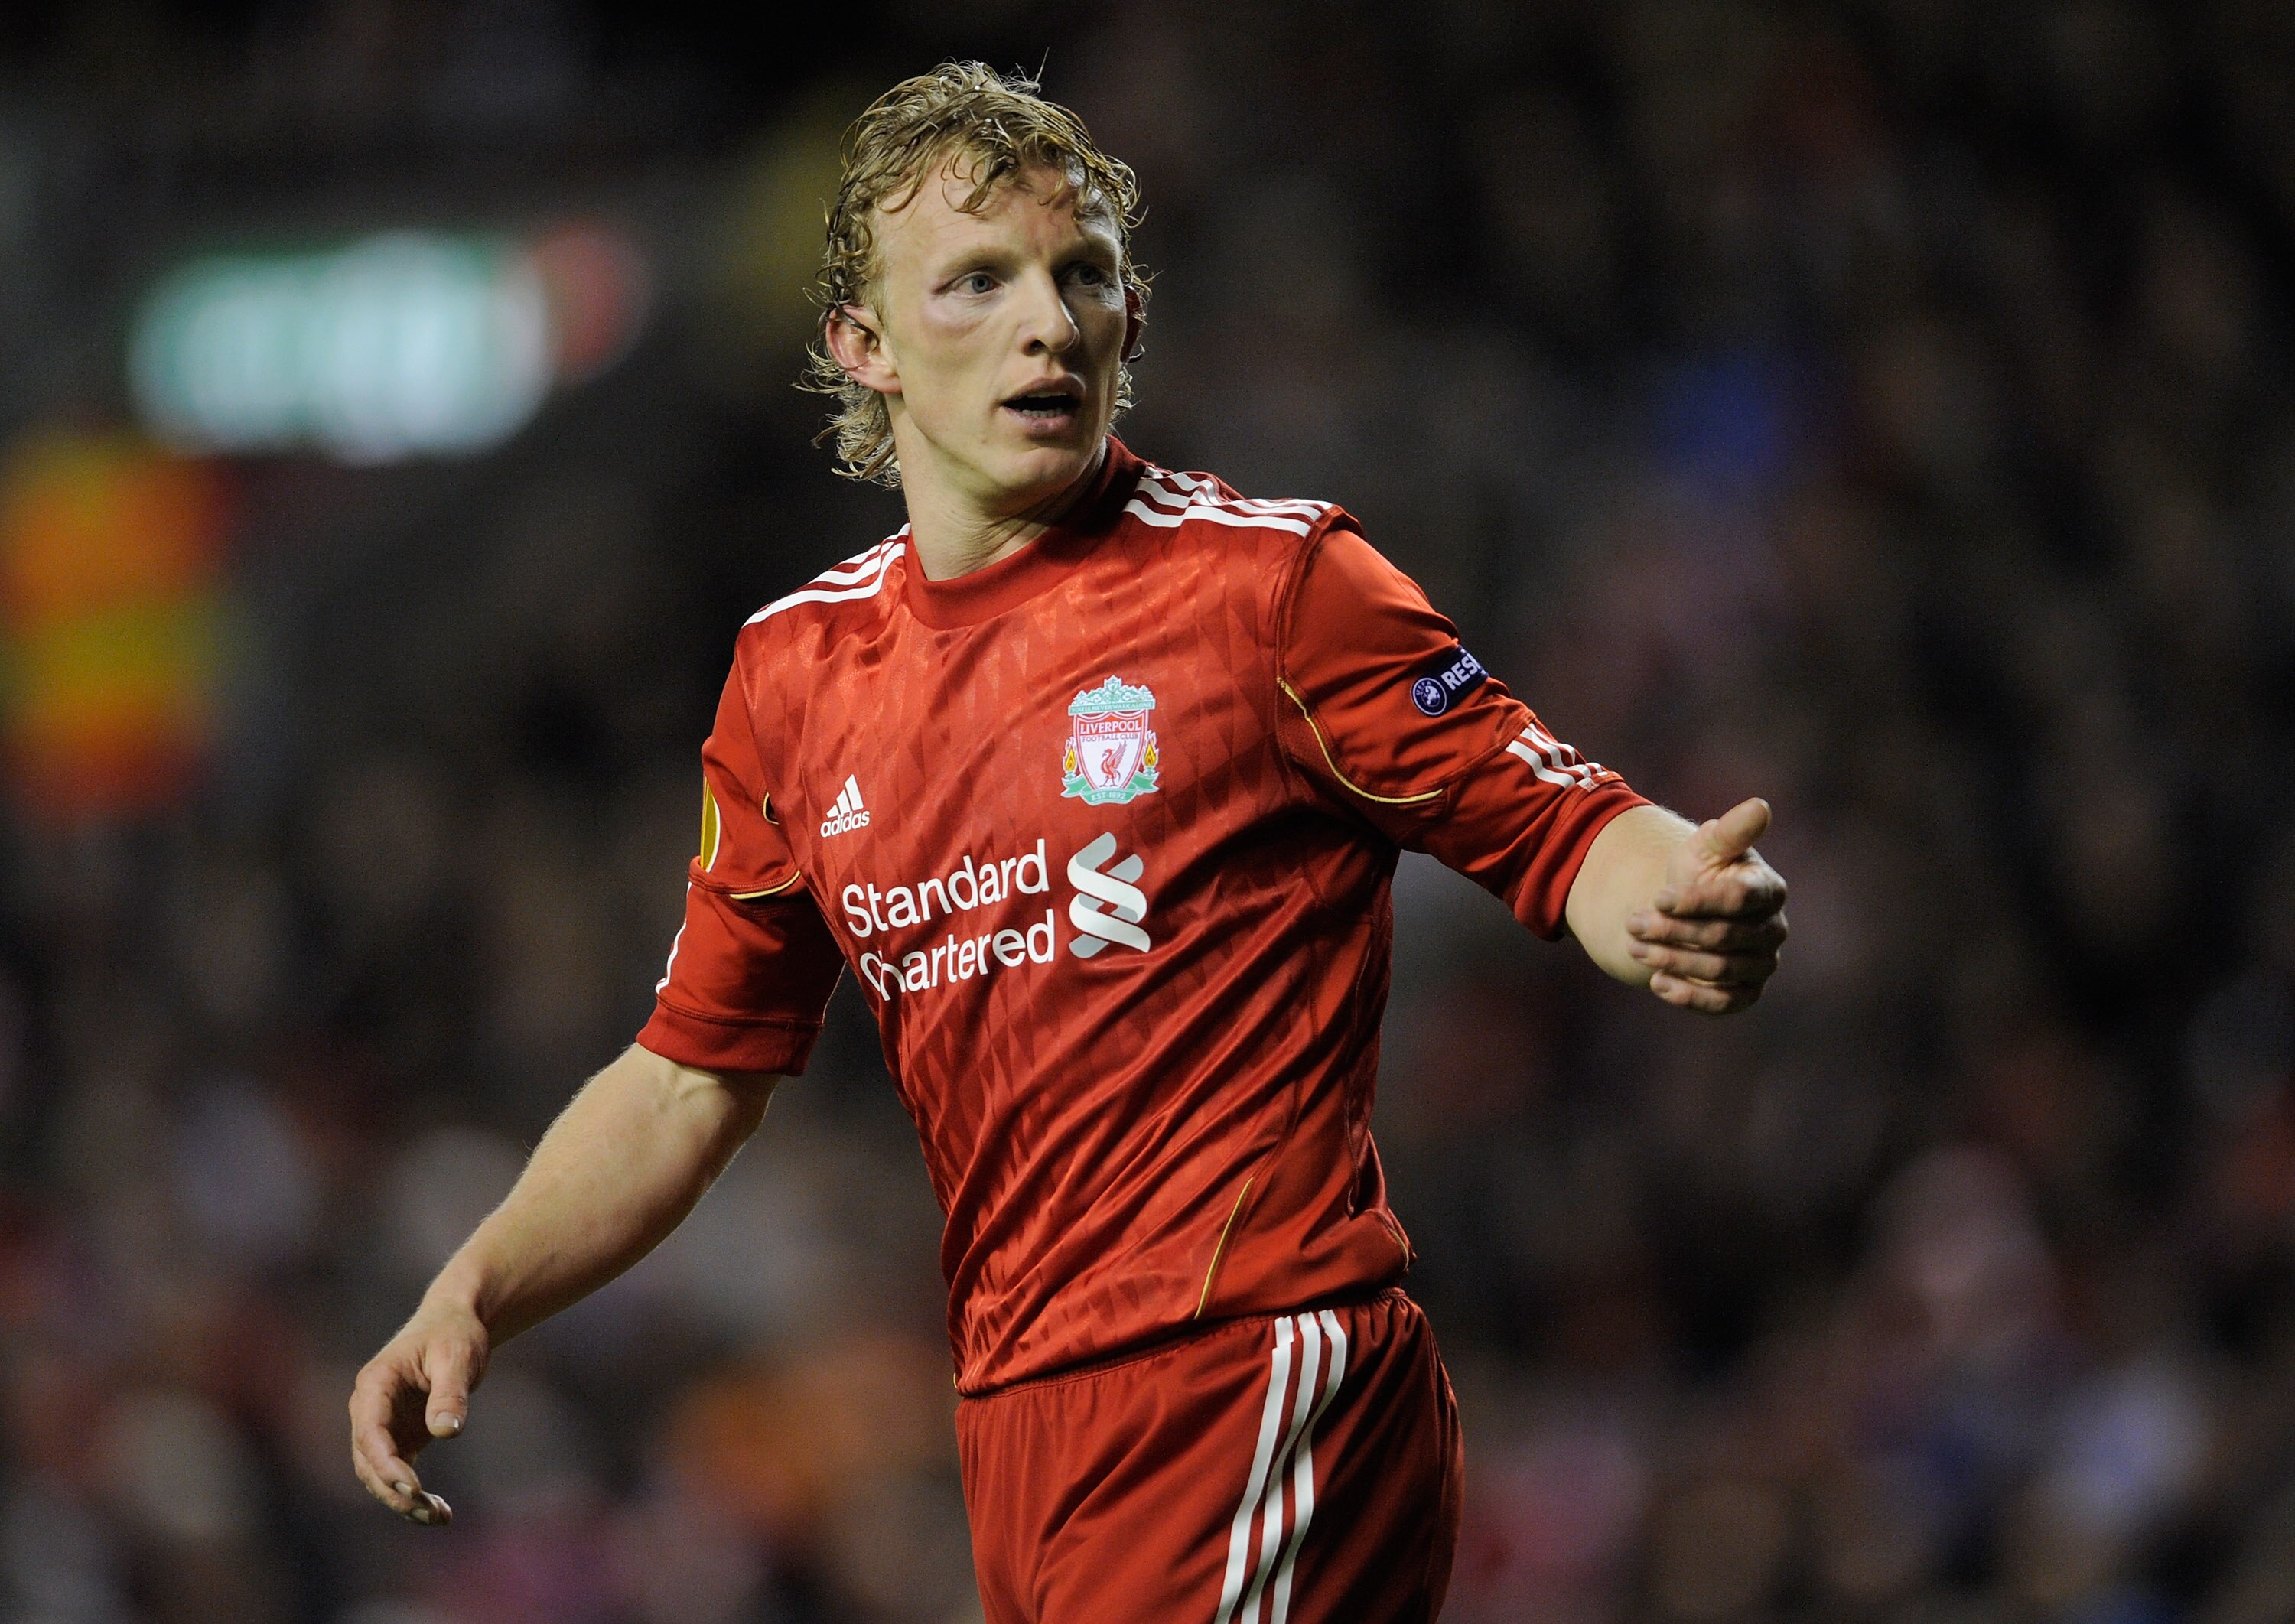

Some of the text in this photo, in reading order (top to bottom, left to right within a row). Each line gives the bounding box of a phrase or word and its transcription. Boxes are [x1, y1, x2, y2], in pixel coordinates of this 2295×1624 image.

[1080, 721, 1141, 734] LIVERPOOL
[820, 811, 870, 838] adidas
[842, 838, 1050, 938] Standard
